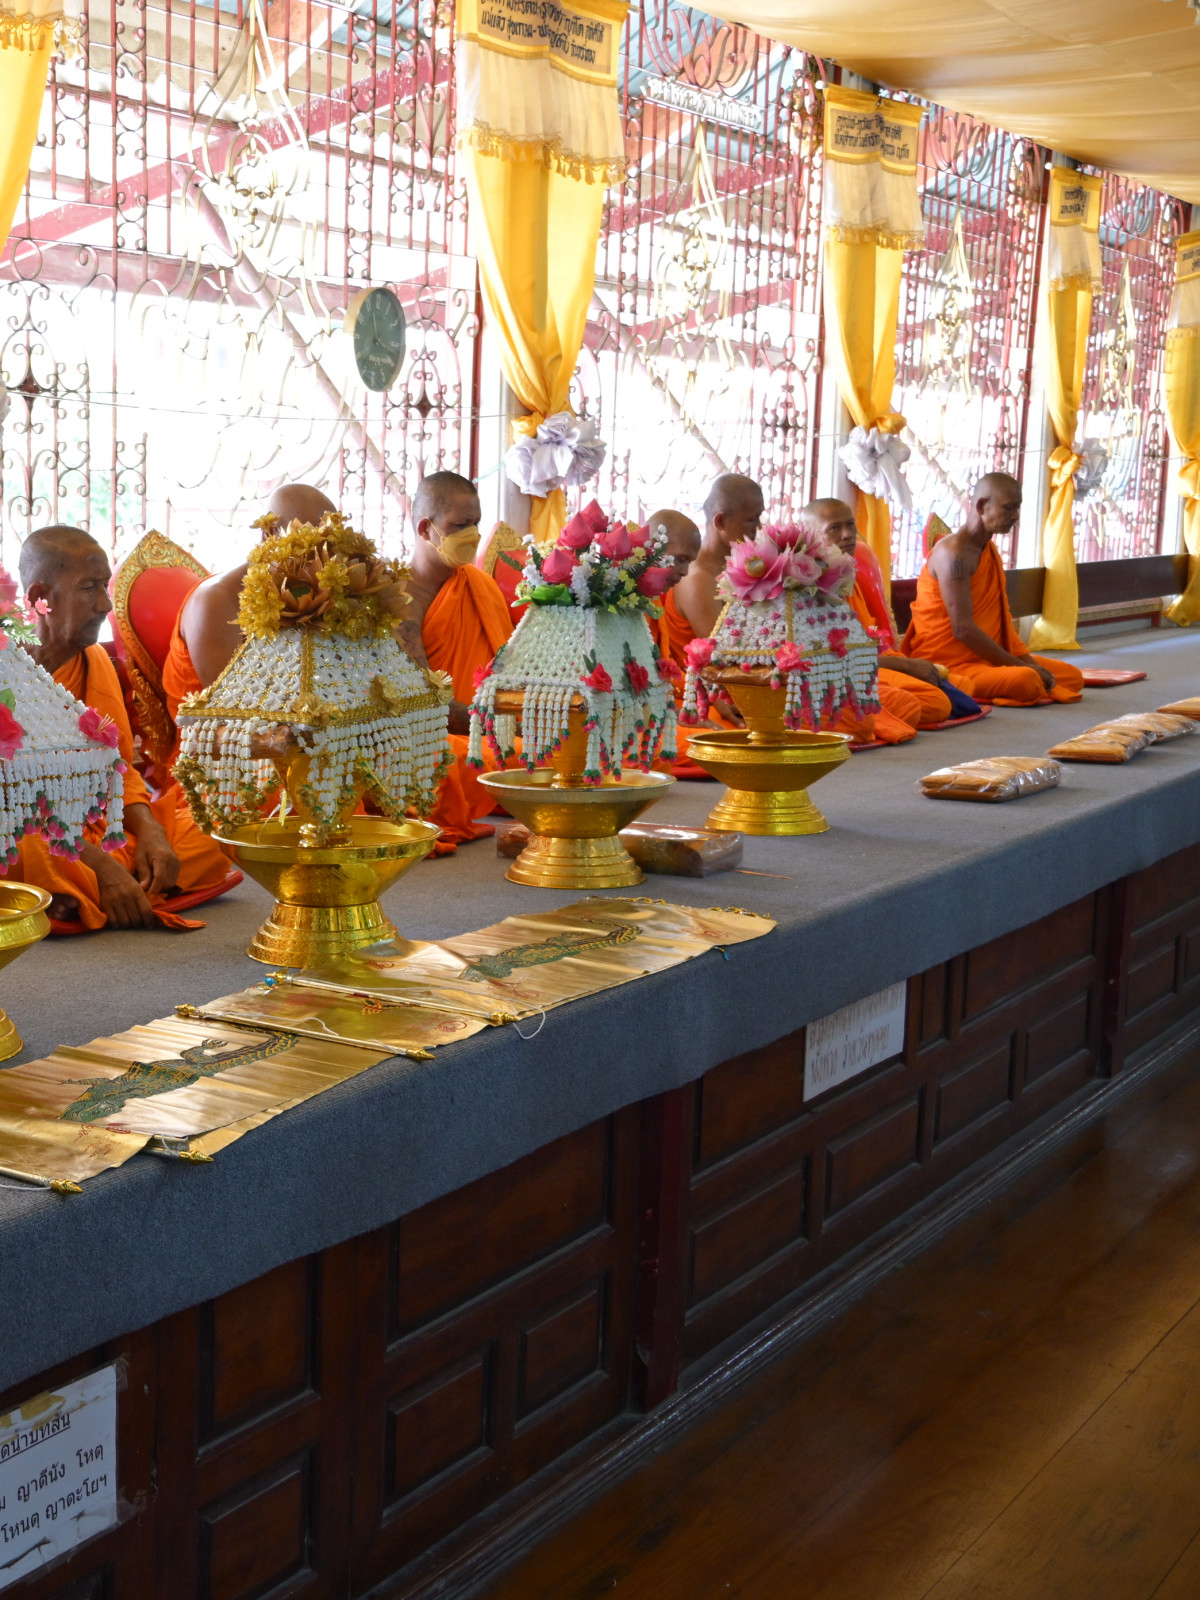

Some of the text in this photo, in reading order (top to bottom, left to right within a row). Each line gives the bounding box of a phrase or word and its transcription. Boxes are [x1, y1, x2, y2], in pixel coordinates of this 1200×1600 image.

[17, 1461, 66, 1503] ญาตีนัง
[75, 1443, 104, 1468] โหตุ
[0, 1511, 40, 1543] โหนตุ
[45, 1473, 108, 1521] ญาตะโยฯ
